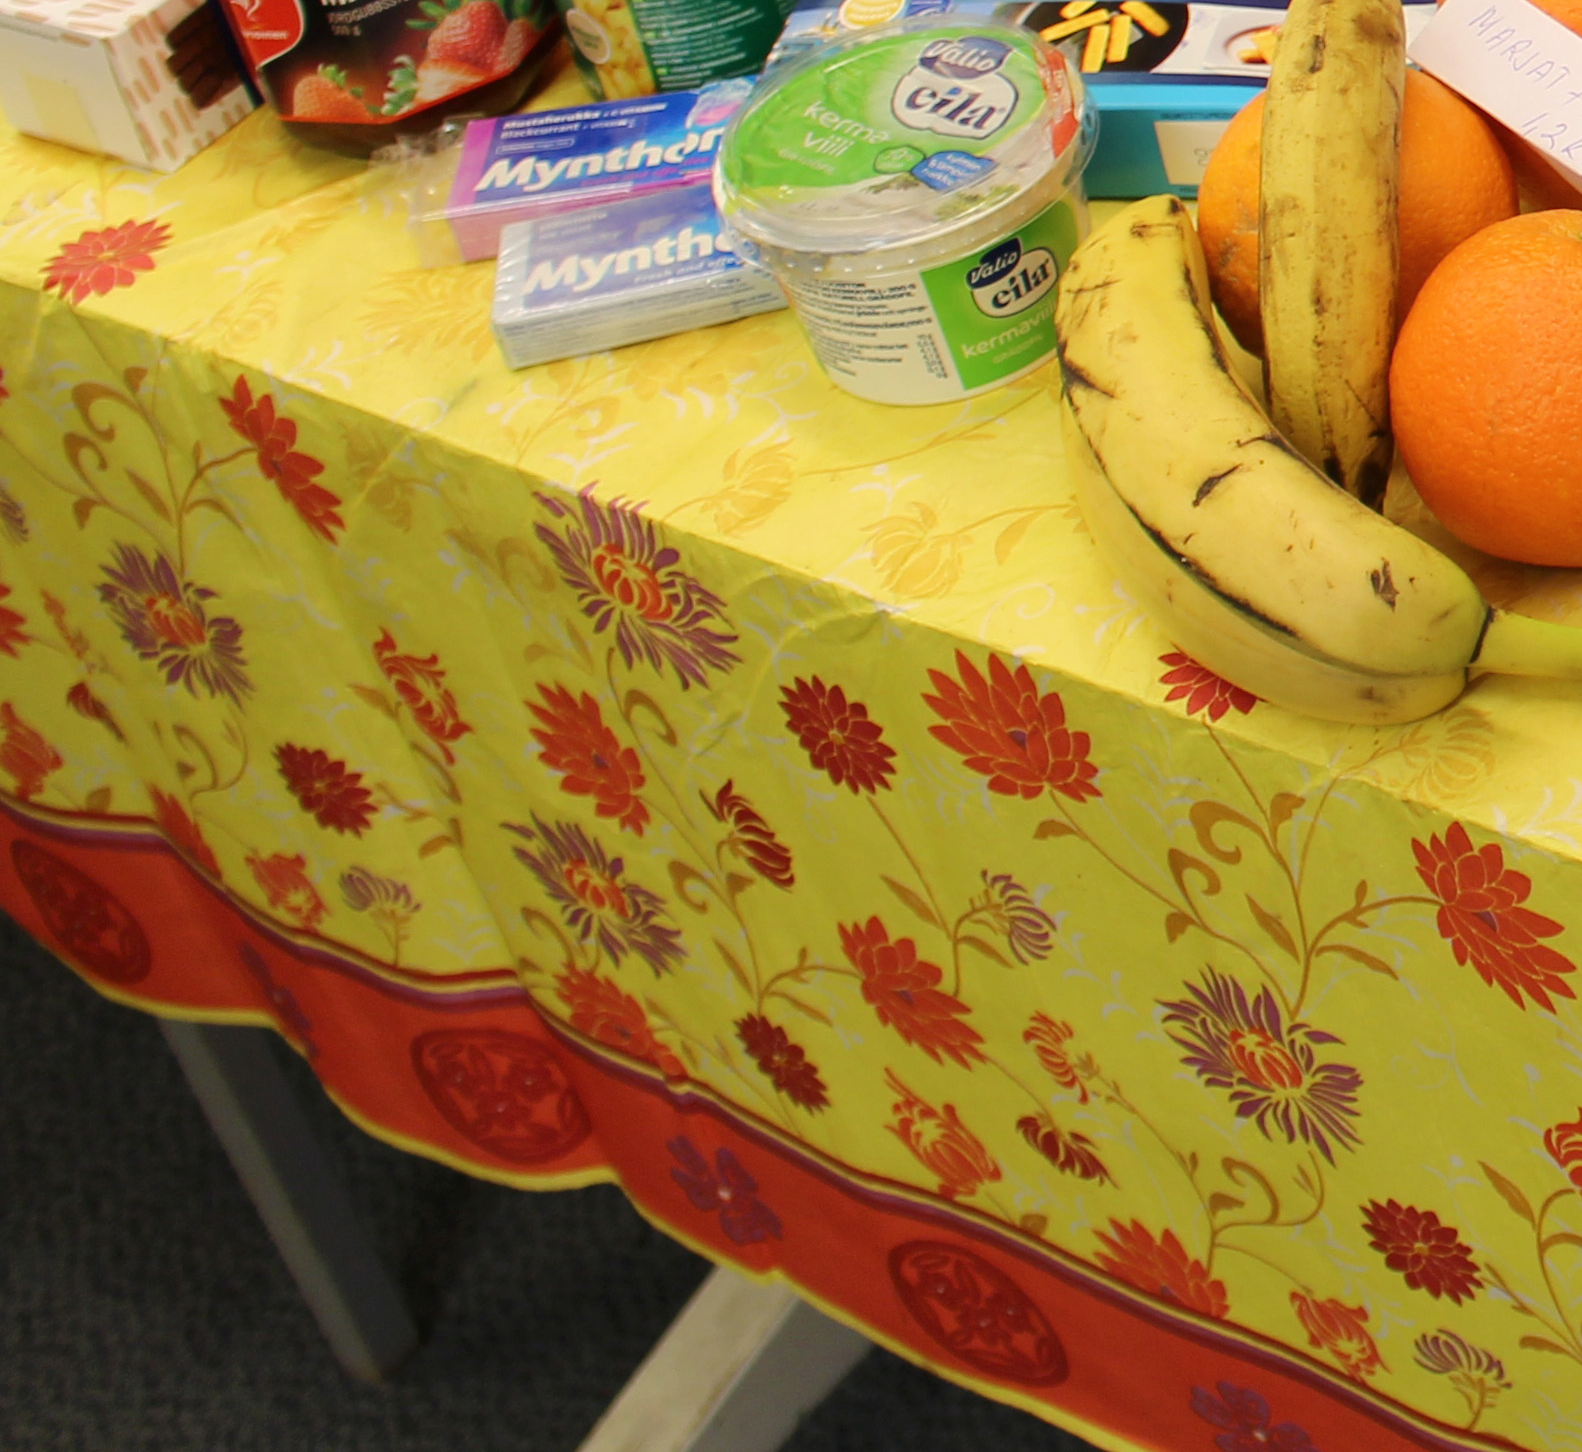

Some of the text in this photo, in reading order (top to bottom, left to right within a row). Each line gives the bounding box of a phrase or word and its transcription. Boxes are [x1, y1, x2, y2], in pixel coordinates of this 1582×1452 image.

[924, 40, 995, 72] Valio
[804, 101, 891, 145] kerma
[905, 86, 999, 131] eila
[803, 129, 855, 157] viili
[970, 250, 1018, 284] Valio
[991, 260, 1051, 310] eila
